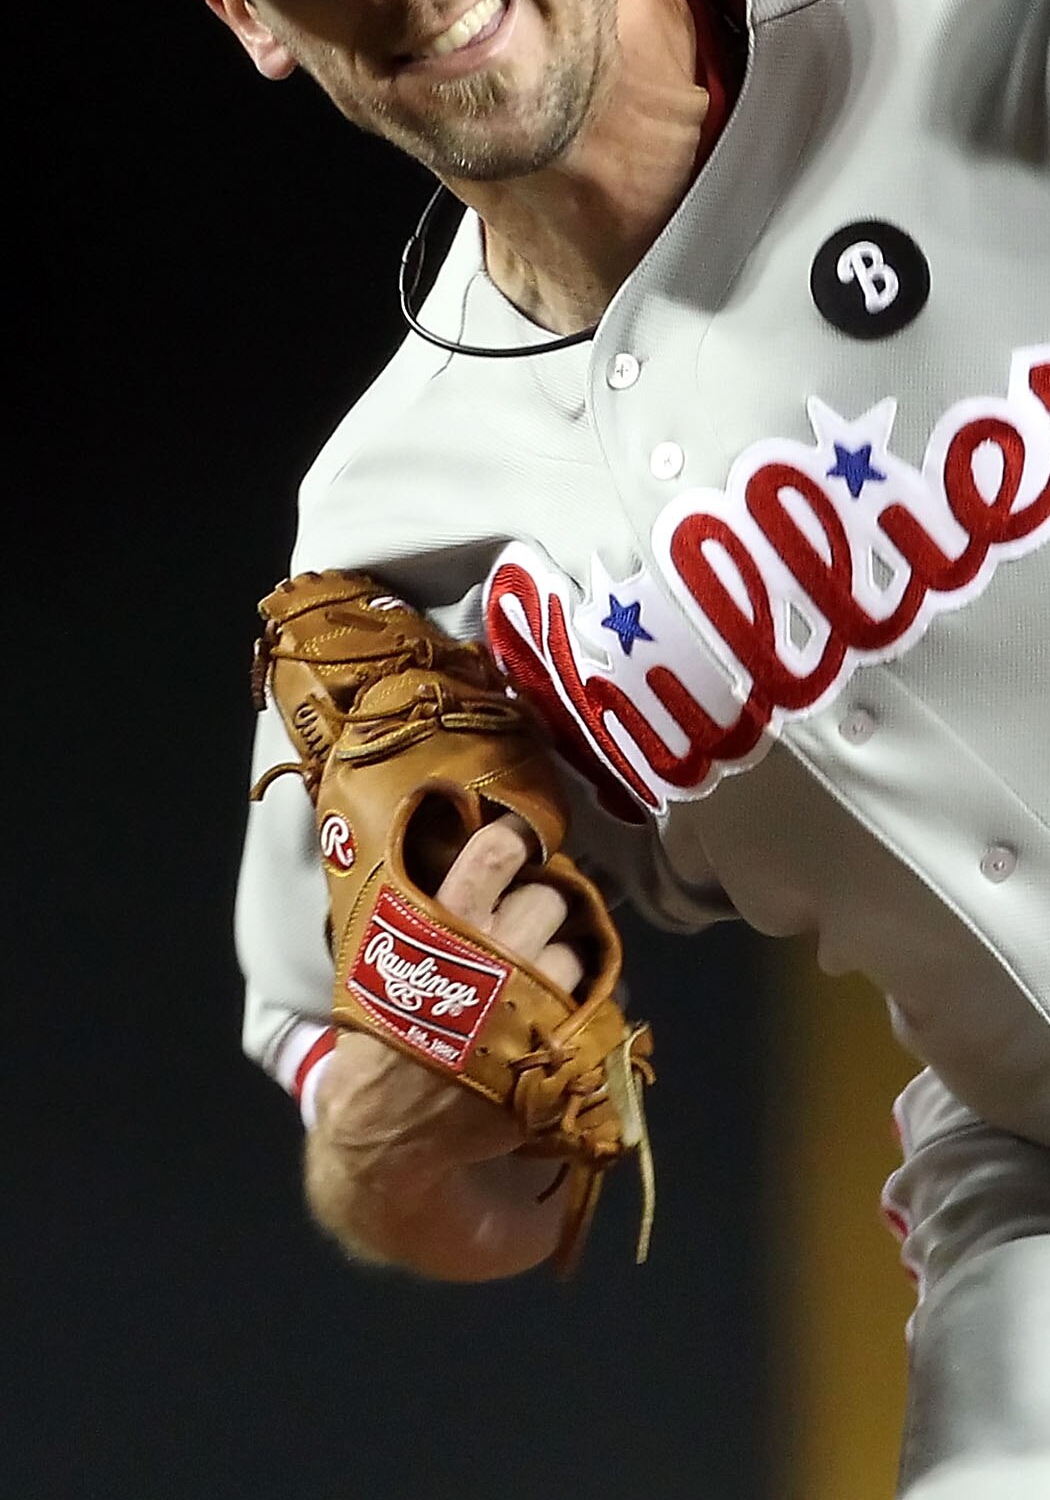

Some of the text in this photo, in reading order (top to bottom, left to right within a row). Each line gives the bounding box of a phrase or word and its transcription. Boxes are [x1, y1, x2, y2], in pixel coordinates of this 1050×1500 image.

[837, 240, 899, 314] B
[321, 816, 354, 867] R
[364, 931, 480, 1016] Rawlings
